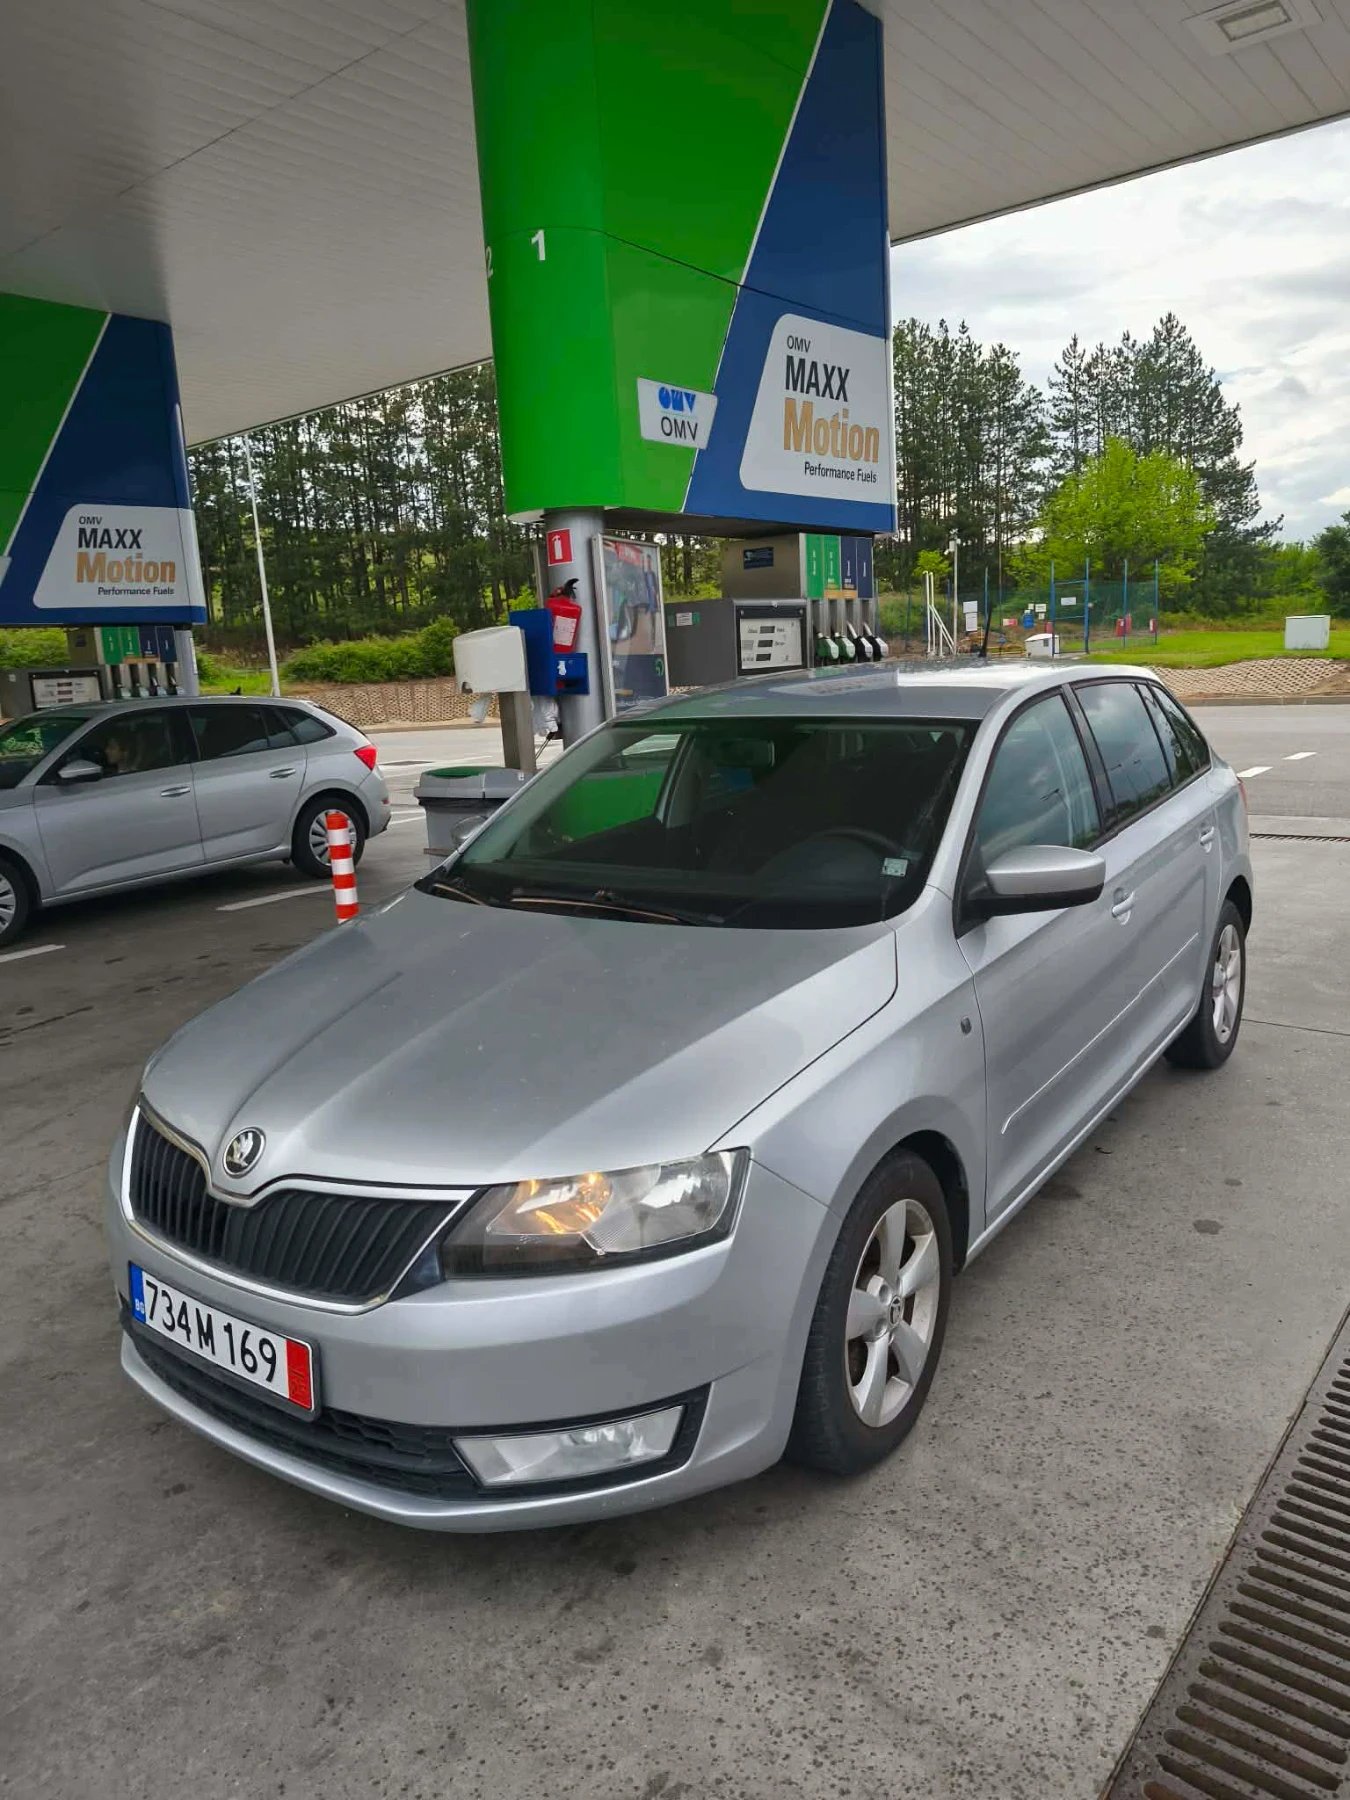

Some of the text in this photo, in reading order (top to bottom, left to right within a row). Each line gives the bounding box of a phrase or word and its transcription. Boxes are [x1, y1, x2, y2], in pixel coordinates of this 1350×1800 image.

[531, 229, 546, 261] 1
[786, 334, 811, 353] OMV
[785, 355, 850, 402] MAXX
[661, 416, 698, 441] OMV
[783, 397, 880, 463] Motion
[804, 461, 877, 484] Performance Fuels
[78, 516, 103, 525] OMV
[78, 527, 143, 549] MAXX
[76, 552, 176, 583] Motion
[98, 586, 175, 596] Performance Fuels
[135, 1298, 145, 1315] BG
